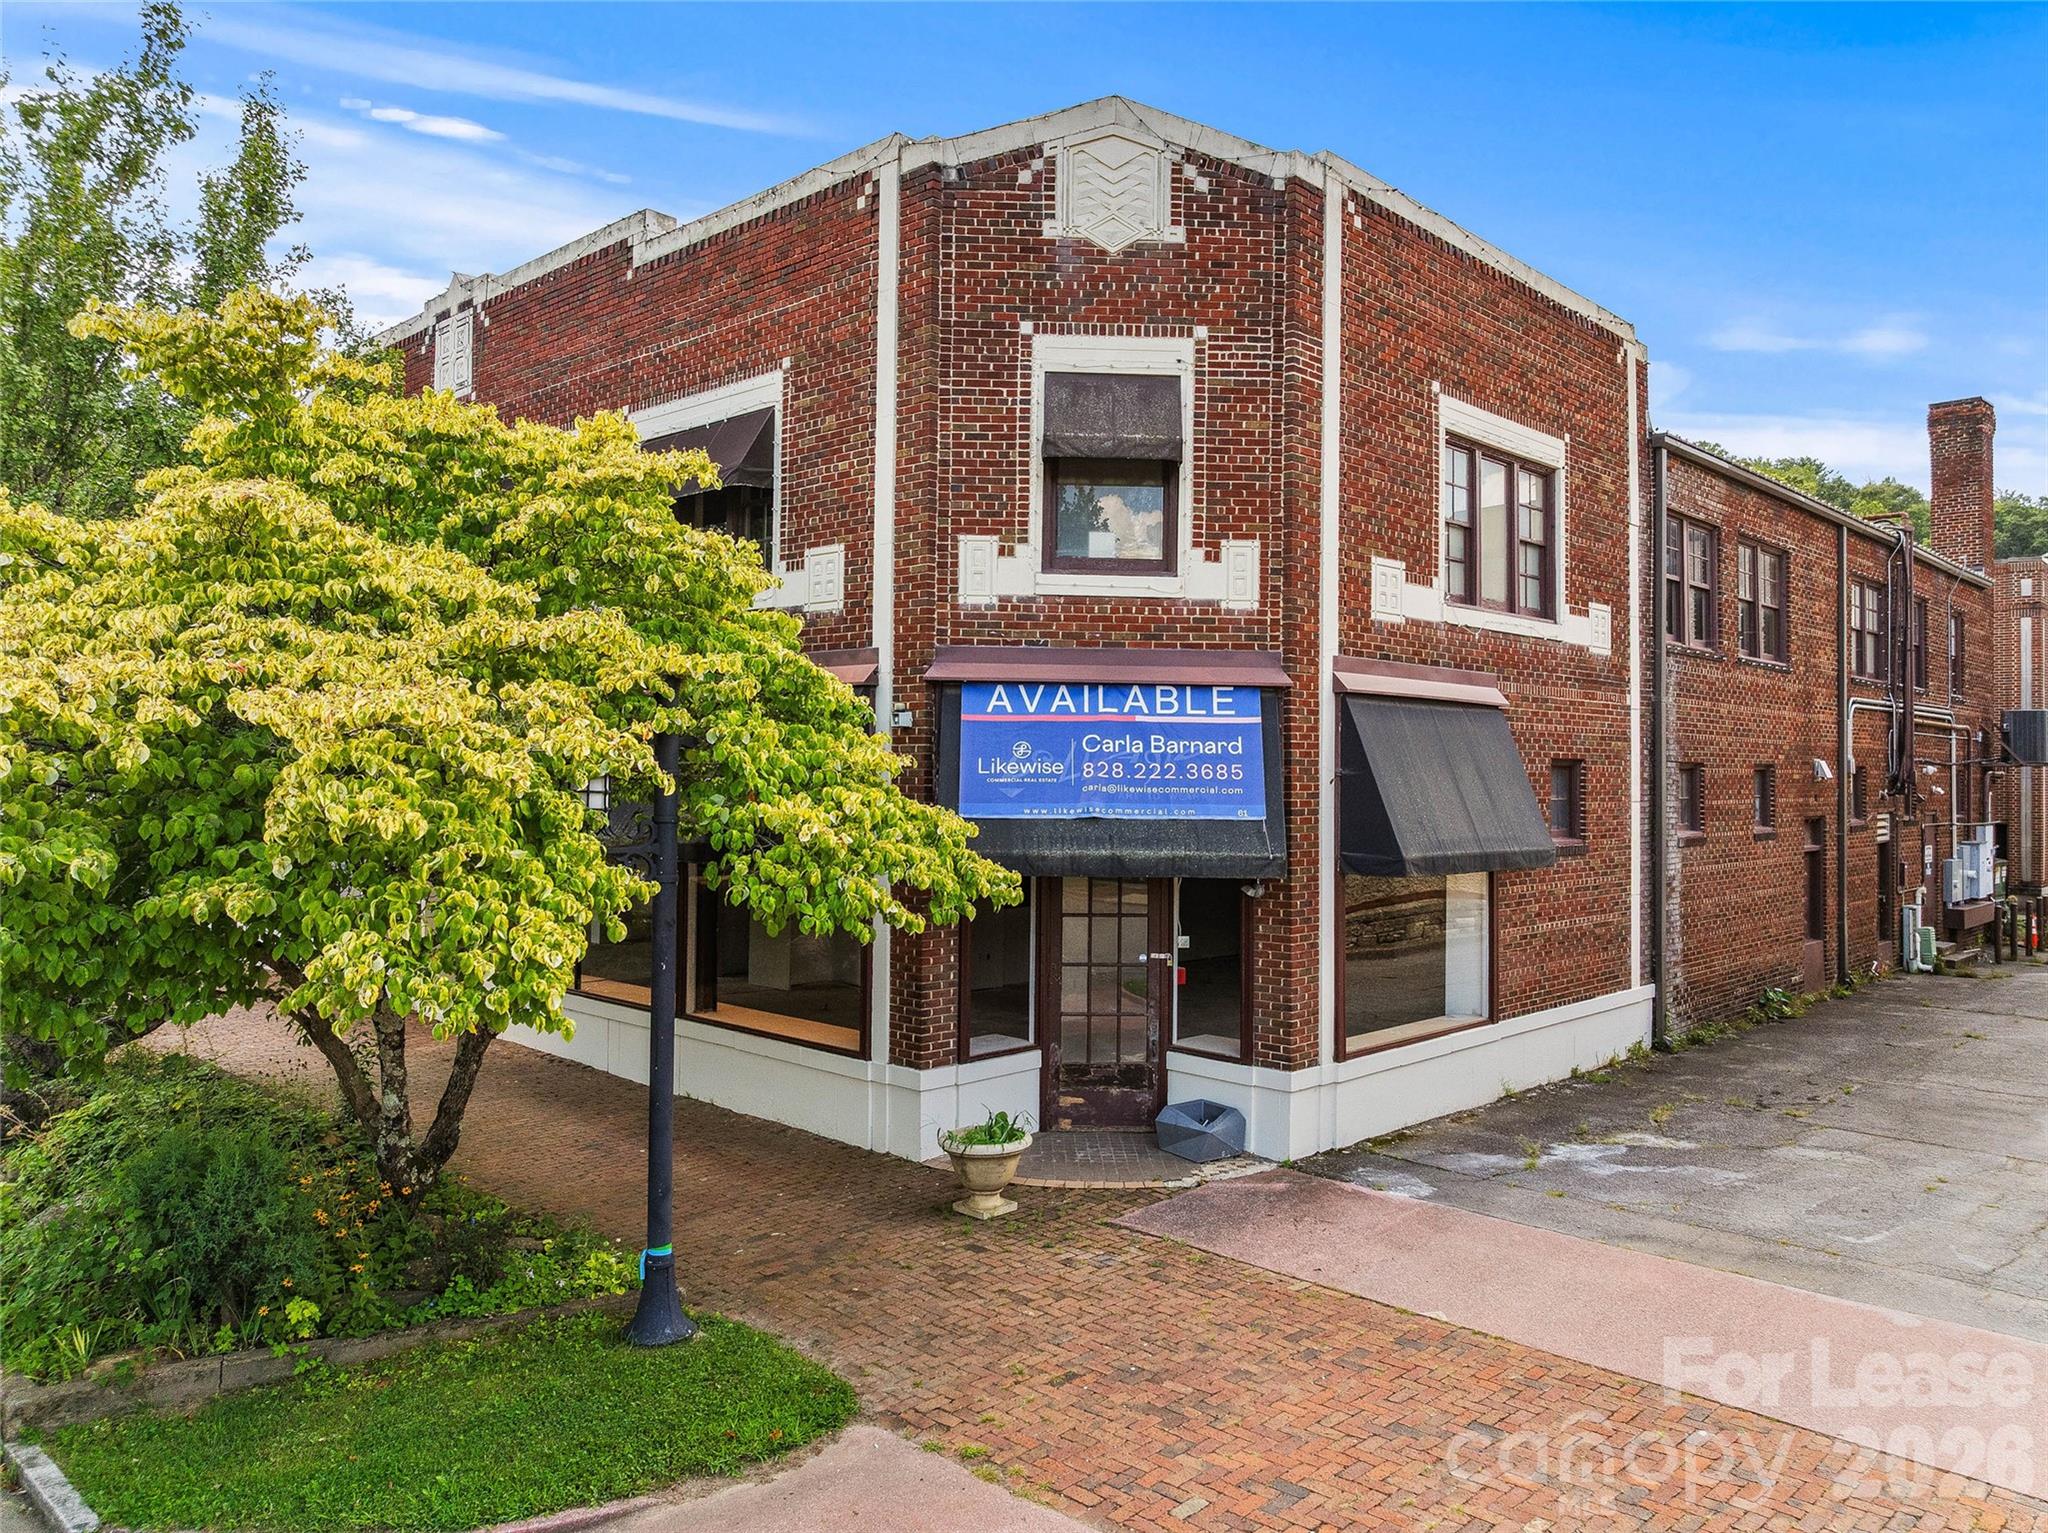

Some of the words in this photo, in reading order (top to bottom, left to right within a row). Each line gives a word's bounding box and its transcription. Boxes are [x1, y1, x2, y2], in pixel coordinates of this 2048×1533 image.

[986, 684, 1235, 715] AVAILABLE
[1081, 734, 1144, 754] Carla
[1150, 735, 1243, 755] Barnard
[978, 757, 1064, 775] Likewise
[1082, 761, 1244, 780] 828.222.3685
[1081, 783, 1244, 795] carla@likewisecommercial.com
[1023, 806, 1196, 816] www.likewisecommercial.com
